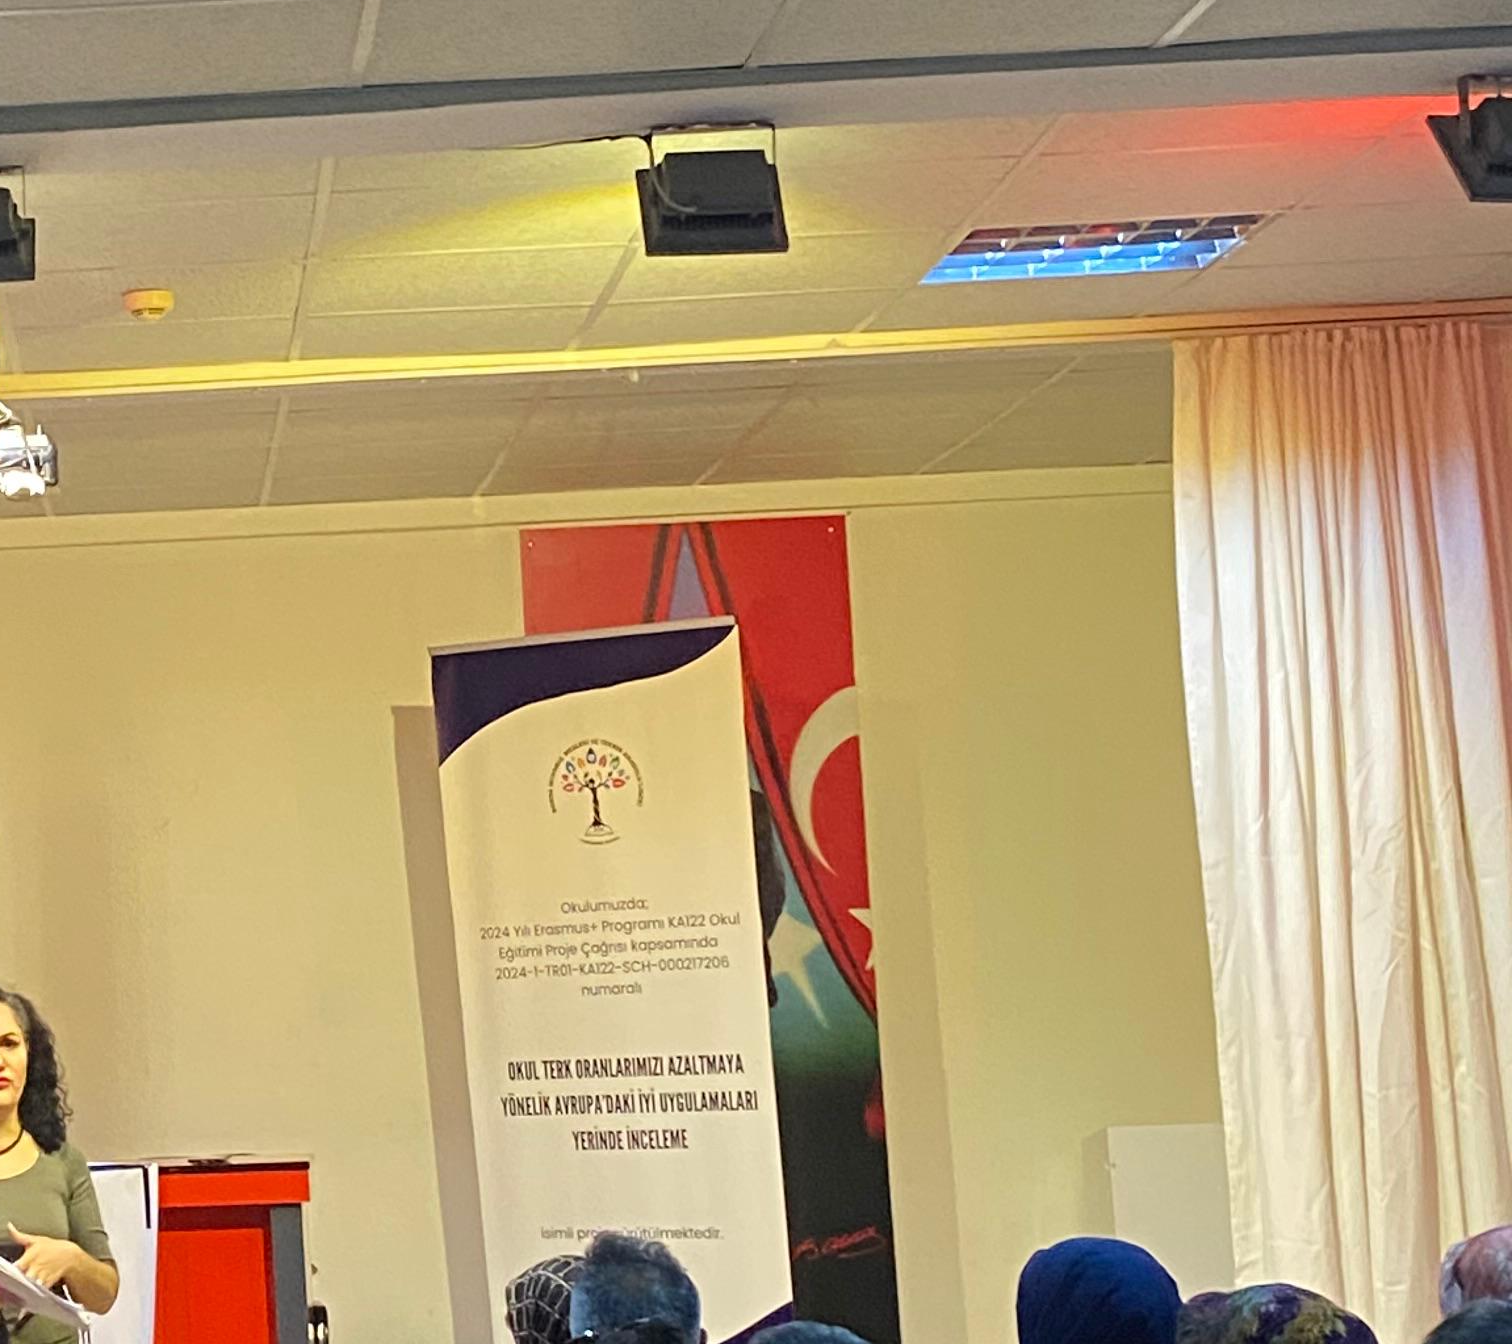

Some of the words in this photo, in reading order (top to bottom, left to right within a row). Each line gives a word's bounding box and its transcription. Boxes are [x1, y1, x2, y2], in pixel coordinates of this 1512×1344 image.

[480, 926, 510, 940] 2024
[534, 921, 598, 937] Erasmus+
[601, 918, 665, 935] Programı
[668, 914, 706, 929] KA122
[709, 912, 740, 926] Okul
[498, 944, 543, 963] Eğitimi
[545, 943, 578, 959] Proje
[580, 940, 627, 958] Çağrısı
[631, 936, 718, 954] kapsamında
[581, 981, 643, 997] numaralı
[507, 1060, 540, 1081] OKUL
[541, 1058, 574, 1080] TERK
[575, 1056, 665, 1079] ORANLARIMIZI
[667, 1054, 745, 1076] AZALTMAYA
[500, 1091, 552, 1117] YÖNELİK
[637, 1087, 656, 1114] İYİ
[659, 1090, 759, 1113] UYGULAMALARI
[572, 1125, 623, 1151] YERİNDE
[625, 1124, 689, 1151] İNCELEME
